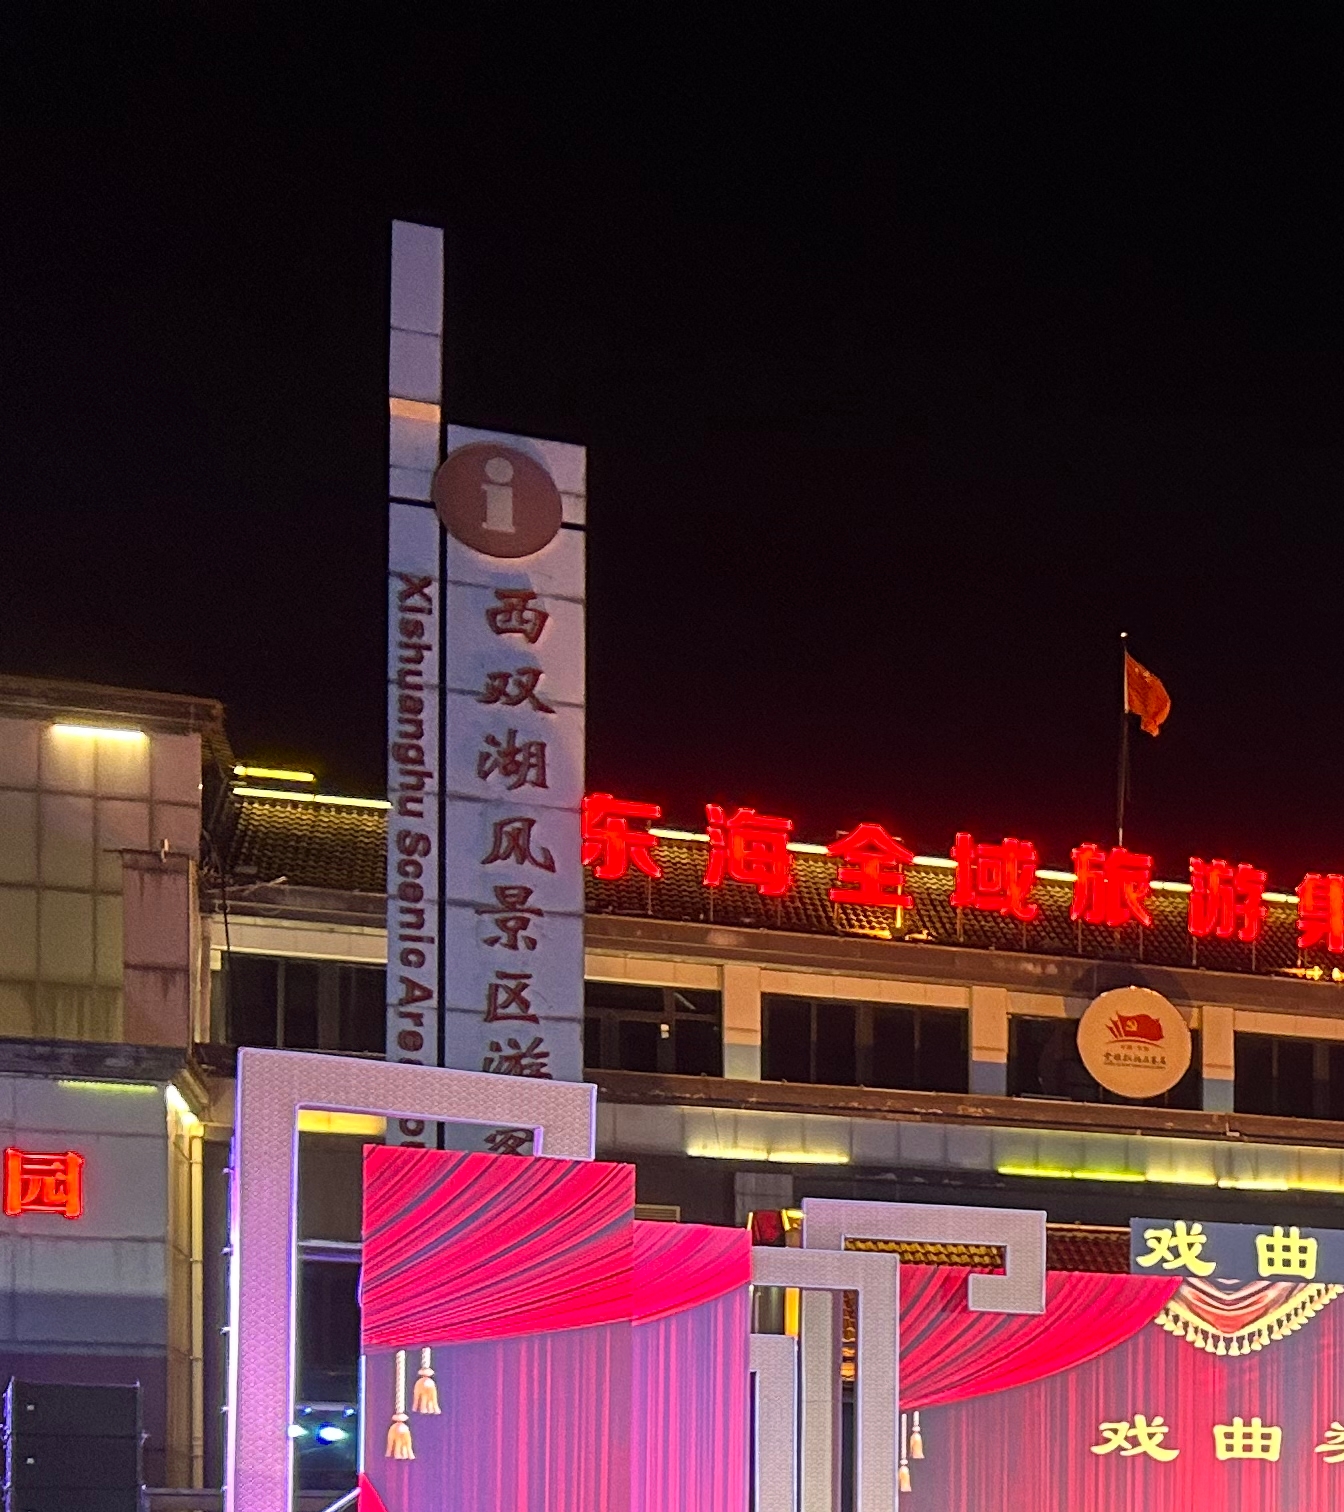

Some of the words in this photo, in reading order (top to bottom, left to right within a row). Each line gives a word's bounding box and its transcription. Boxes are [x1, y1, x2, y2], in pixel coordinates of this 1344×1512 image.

[396, 829, 435, 969] Scenic
[398, 974, 434, 1065] Are
[4, 1148, 83, 1219] 园
